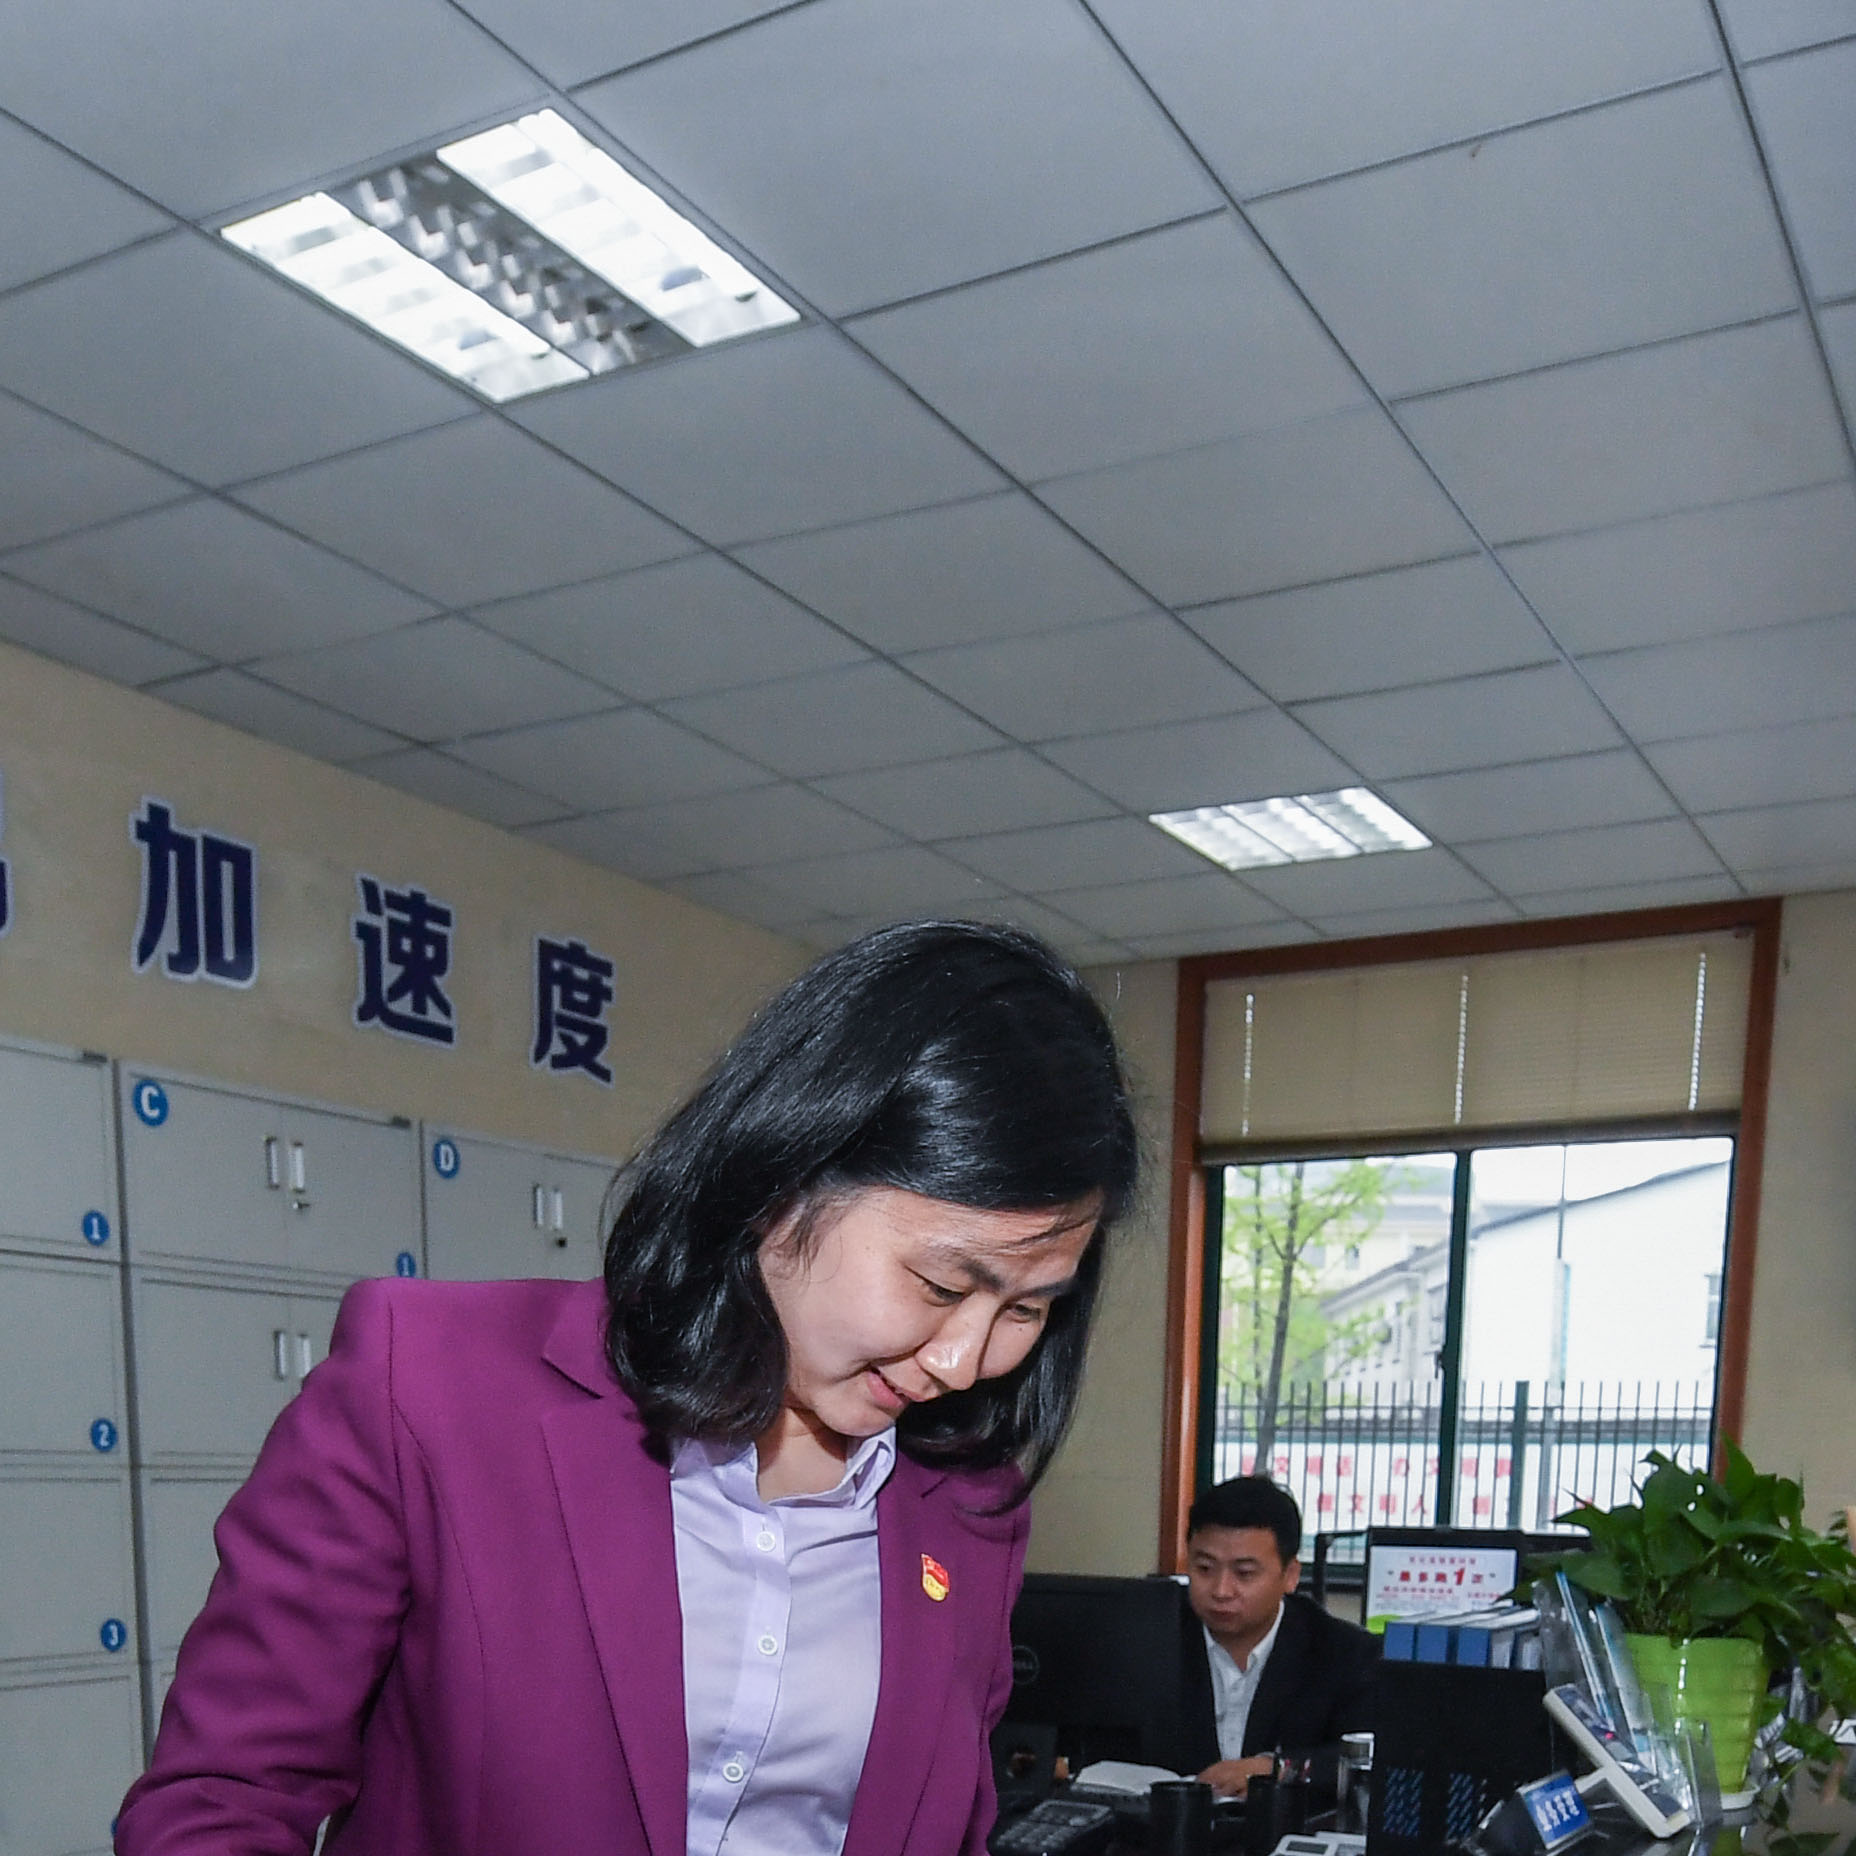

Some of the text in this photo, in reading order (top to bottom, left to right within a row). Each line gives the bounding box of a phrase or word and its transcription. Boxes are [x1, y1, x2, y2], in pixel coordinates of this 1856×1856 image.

[140, 1085, 161, 1118] C
[439, 1144, 455, 1171] D
[90, 1217, 101, 1241] 1
[98, 1423, 110, 1447] 2
[107, 1624, 119, 1646] 3
